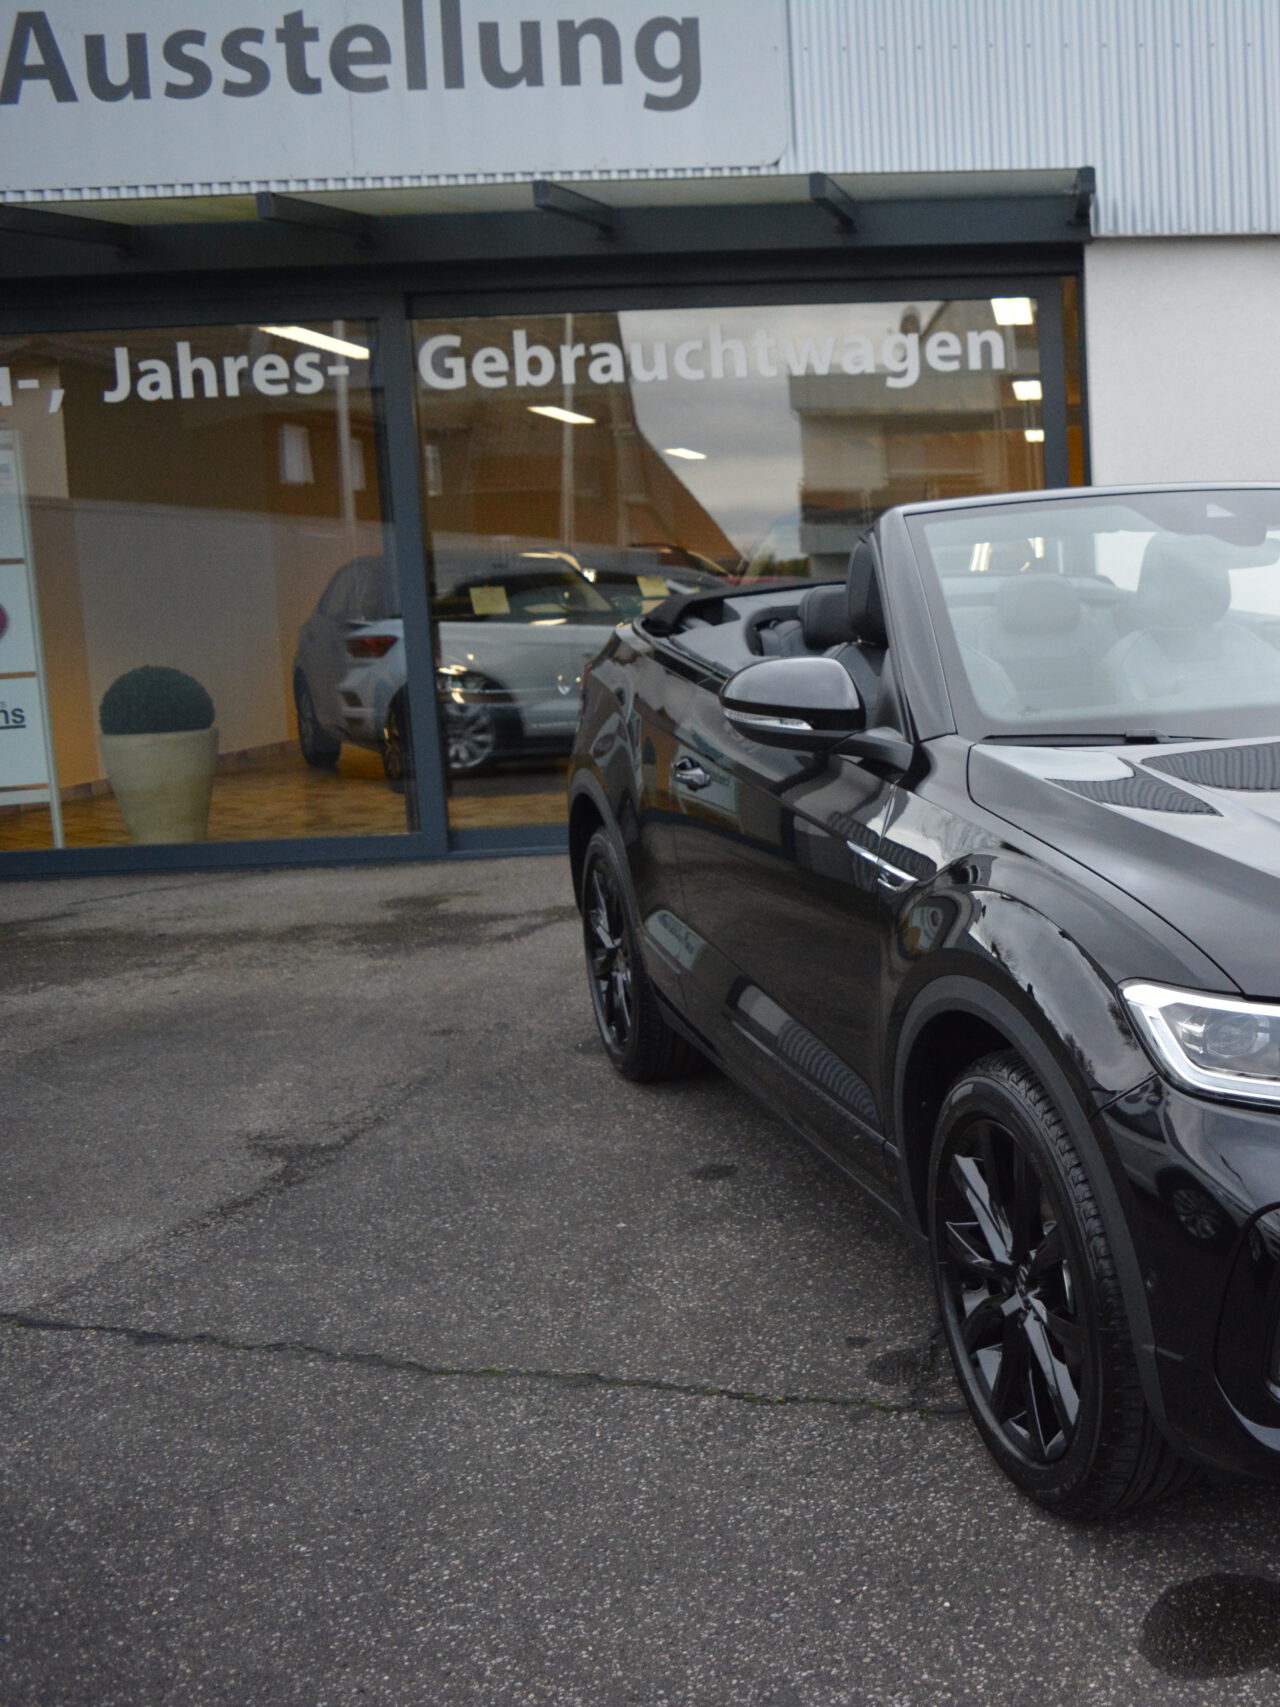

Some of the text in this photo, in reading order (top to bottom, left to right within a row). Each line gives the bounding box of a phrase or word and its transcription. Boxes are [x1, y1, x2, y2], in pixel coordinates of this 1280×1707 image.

[0, 0, 703, 112] Ausstellung
[103, 341, 350, 404] Jahres-
[417, 322, 1006, 390] Gebrauchtwagen
